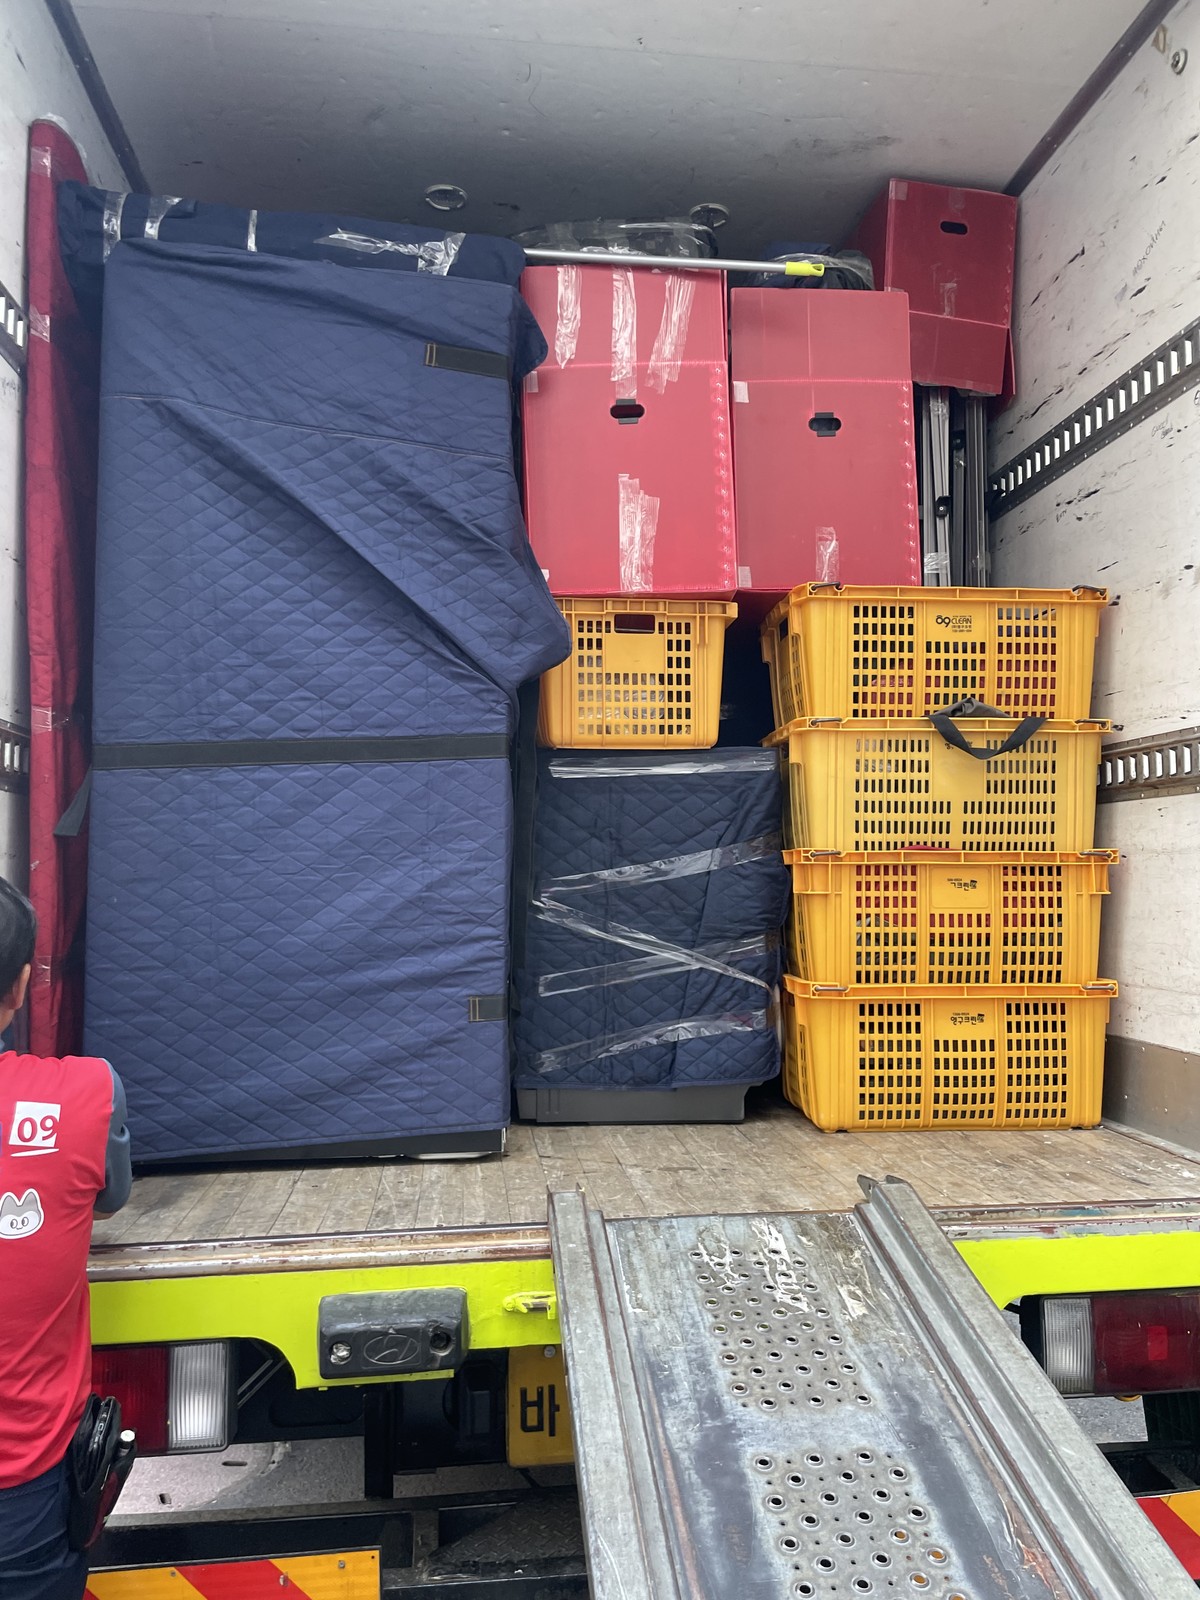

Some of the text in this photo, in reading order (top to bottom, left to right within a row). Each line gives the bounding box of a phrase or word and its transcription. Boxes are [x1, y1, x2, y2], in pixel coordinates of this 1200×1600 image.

[950, 1016, 977, 1026] 영구크린
[17, 1115, 59, 1143] 09
[520, 1384, 560, 1437] 바
